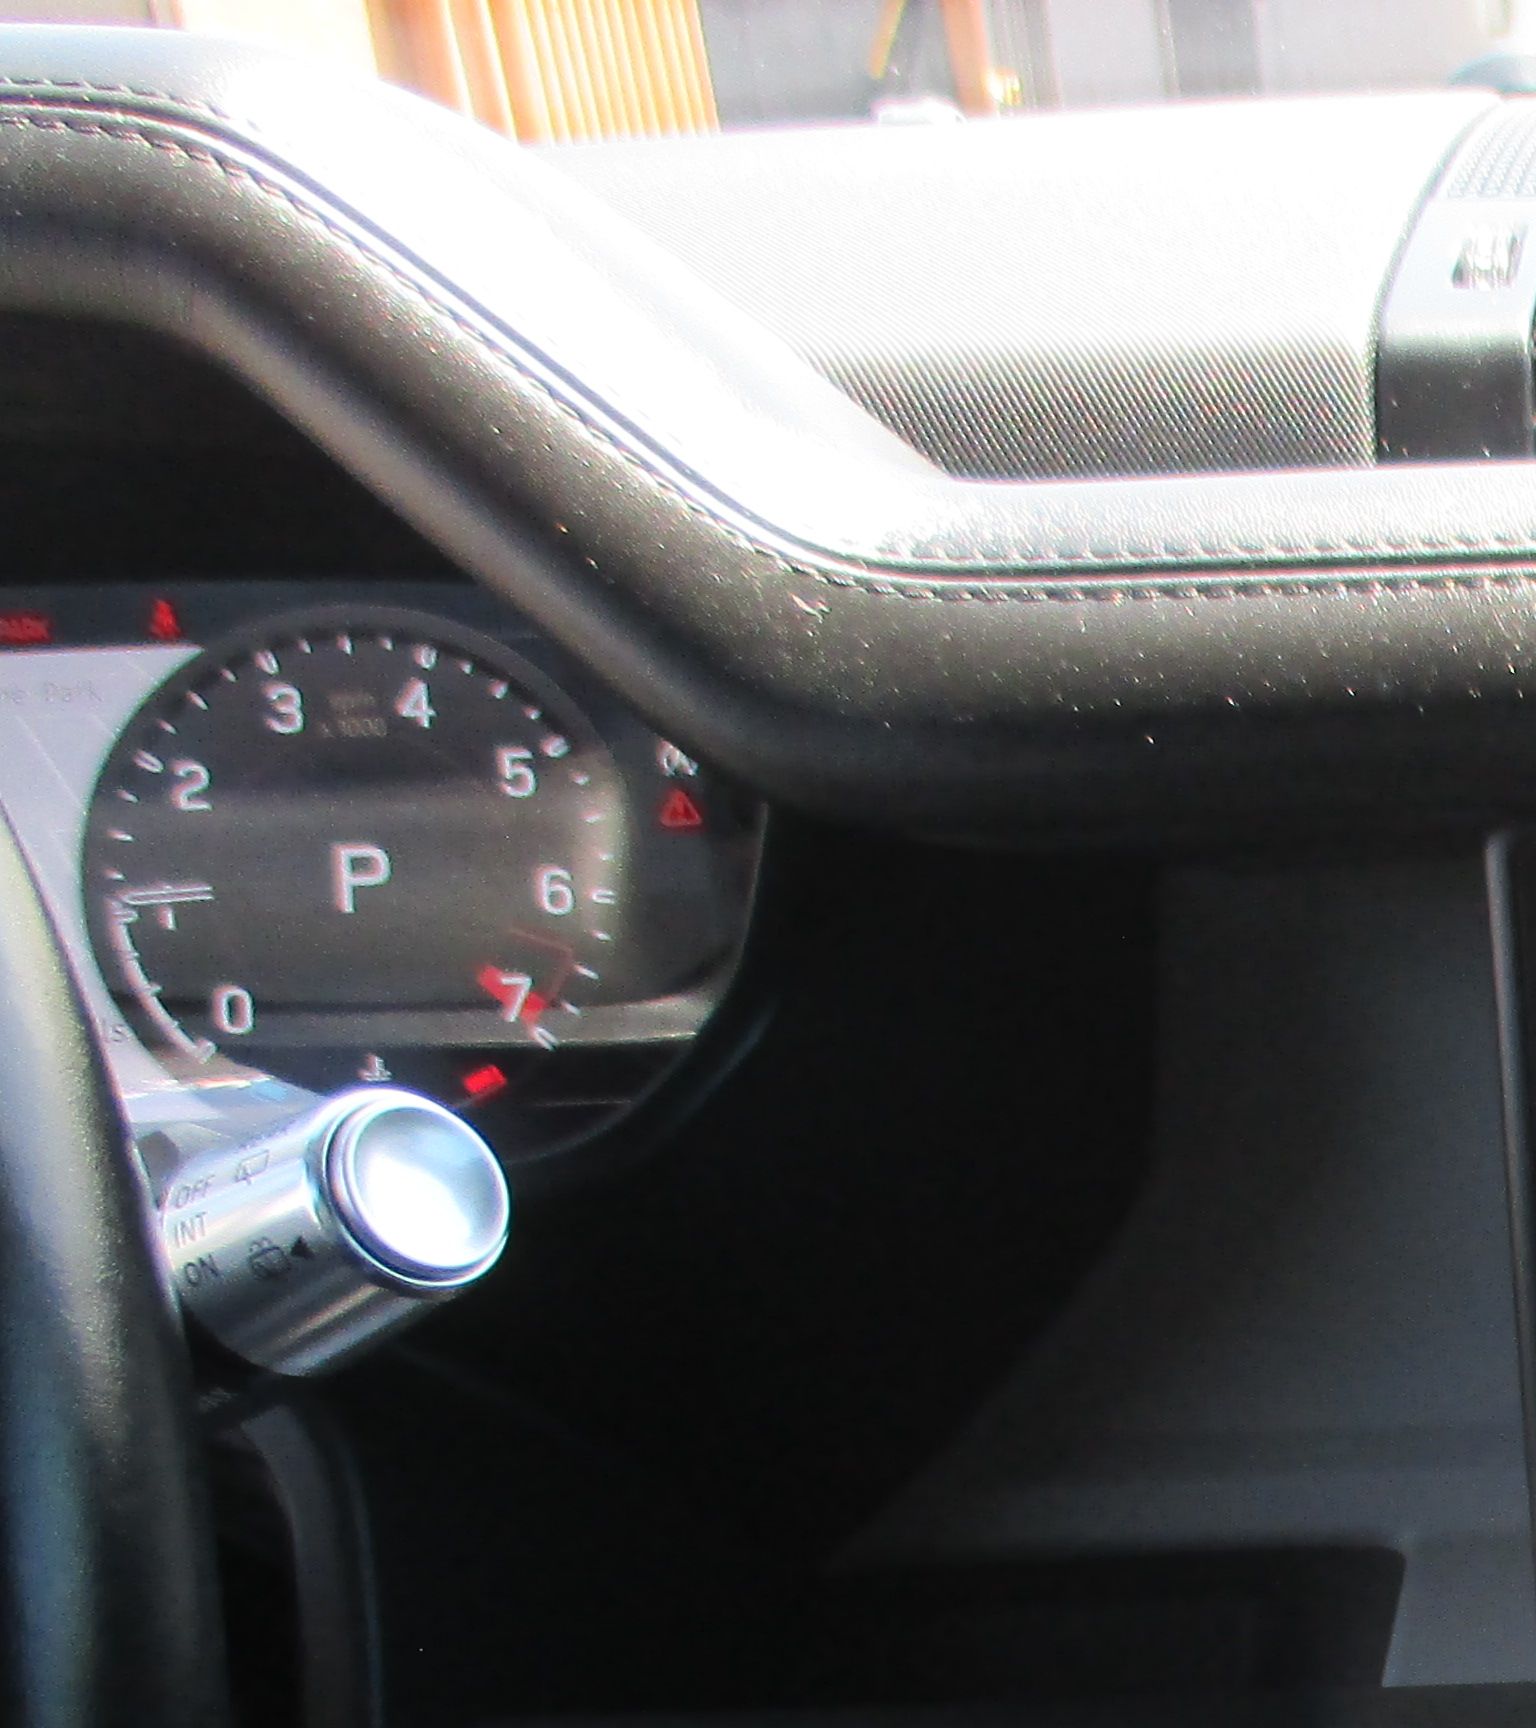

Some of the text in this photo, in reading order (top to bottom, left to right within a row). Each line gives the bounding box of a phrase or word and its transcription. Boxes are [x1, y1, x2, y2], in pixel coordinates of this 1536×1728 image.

[263, 683, 305, 735] 3
[398, 676, 437, 729] 4
[170, 759, 212, 810] 2
[497, 747, 537, 798] 5
[331, 842, 392, 914] P
[534, 866, 574, 917] 6
[211, 985, 256, 1035] 0
[498, 975, 535, 1024] 7
[173, 1211, 207, 1249] INT
[183, 1254, 220, 1286] ON
